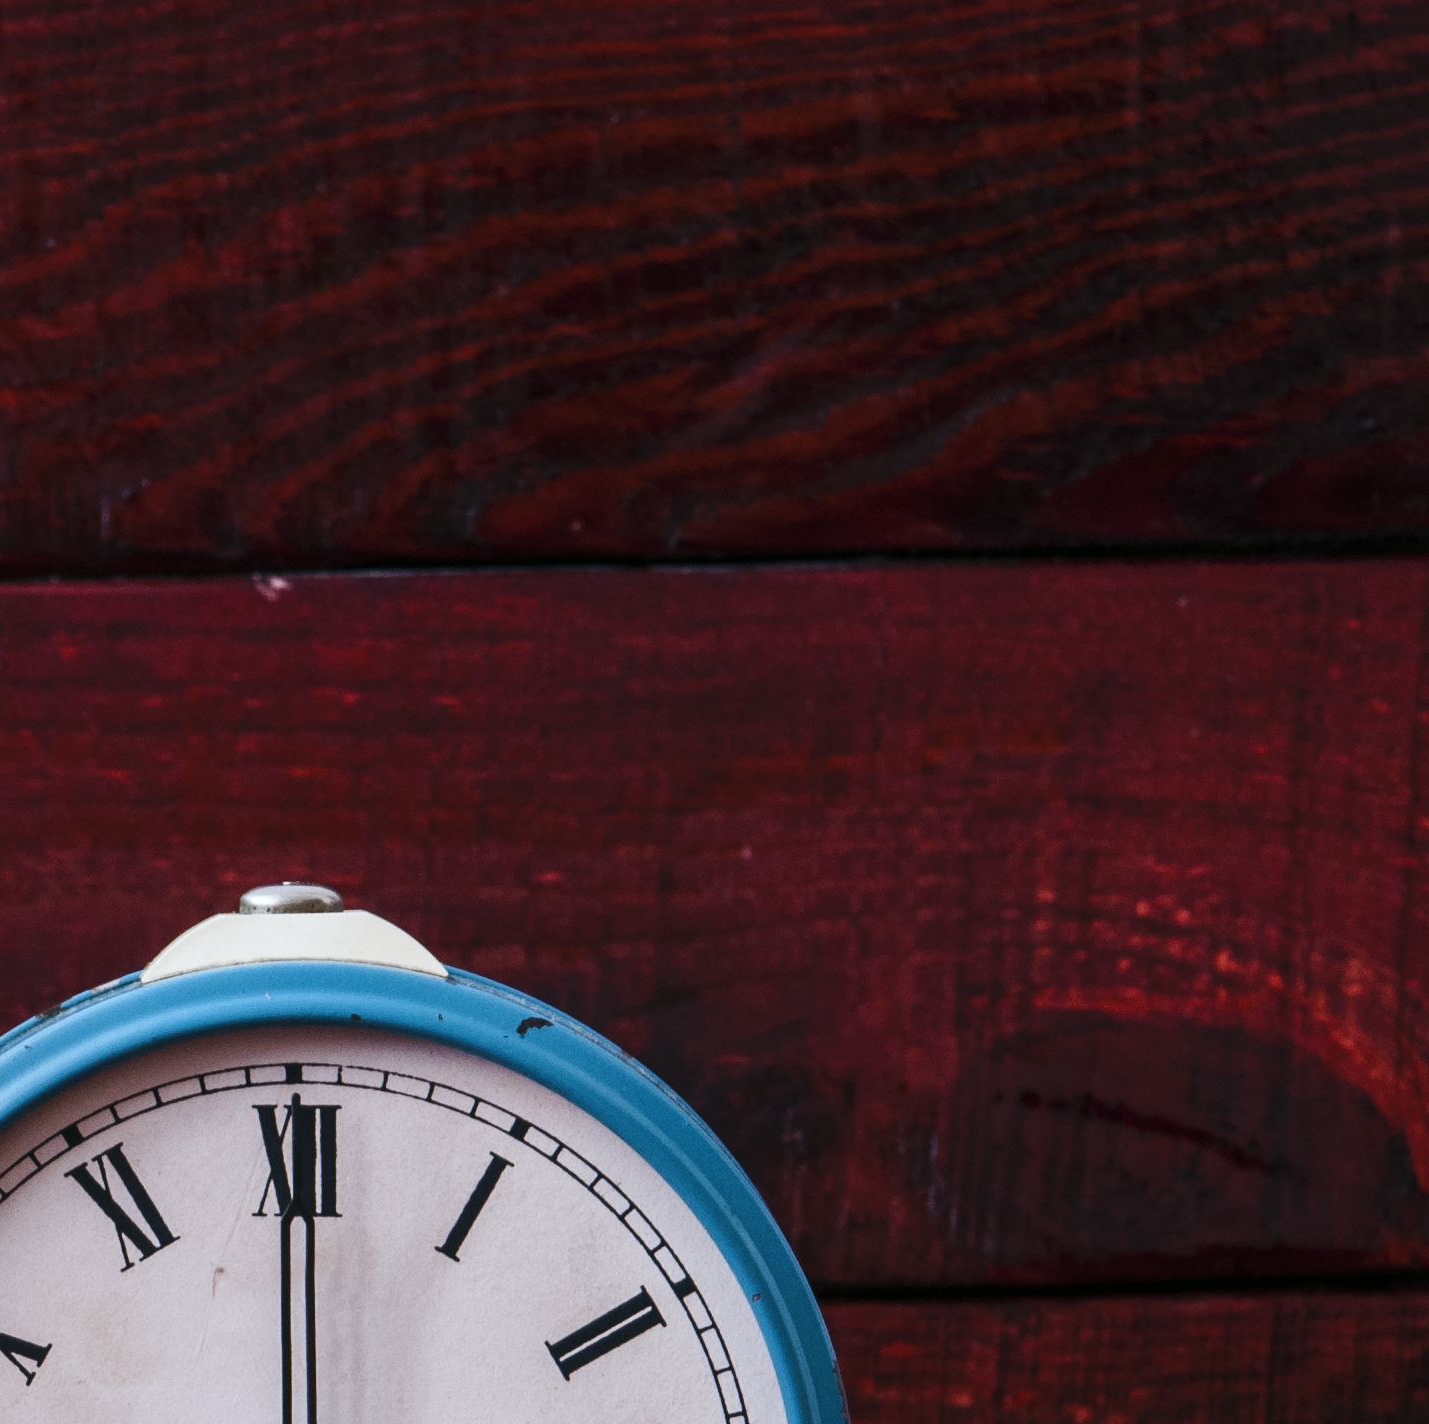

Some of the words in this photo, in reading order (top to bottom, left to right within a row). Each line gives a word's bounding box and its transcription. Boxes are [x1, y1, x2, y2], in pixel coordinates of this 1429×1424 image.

[64, 1142, 180, 1272] XI
[252, 1104, 342, 1217] XII
[435, 1152, 514, 1262] I
[545, 1285, 667, 1381] II
